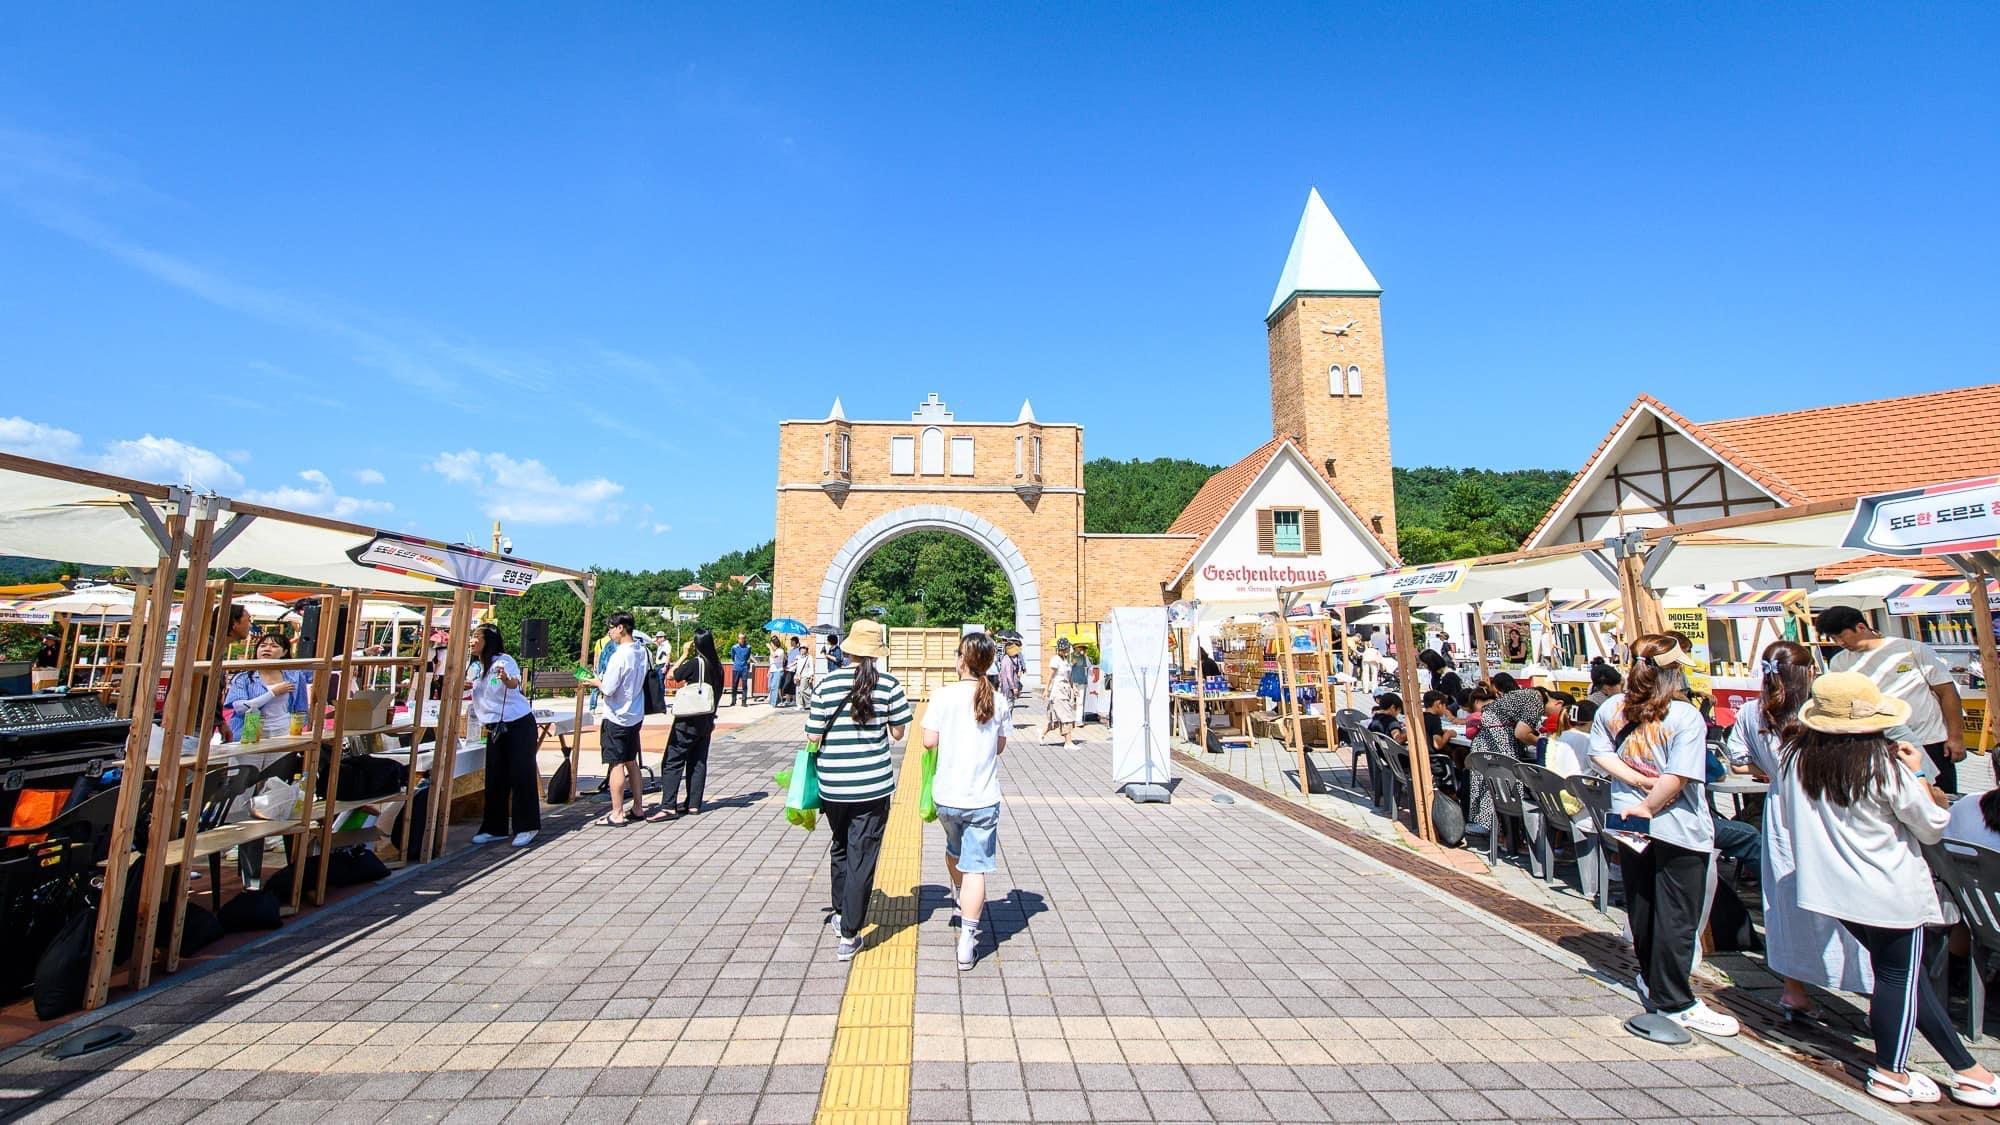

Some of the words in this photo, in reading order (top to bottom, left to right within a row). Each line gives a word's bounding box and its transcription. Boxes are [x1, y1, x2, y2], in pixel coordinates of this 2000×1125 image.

[1890, 512, 1931, 531] 도도한
[1937, 503, 1986, 523] 도르프
[1203, 565, 1327, 584] Geschenkehaus
